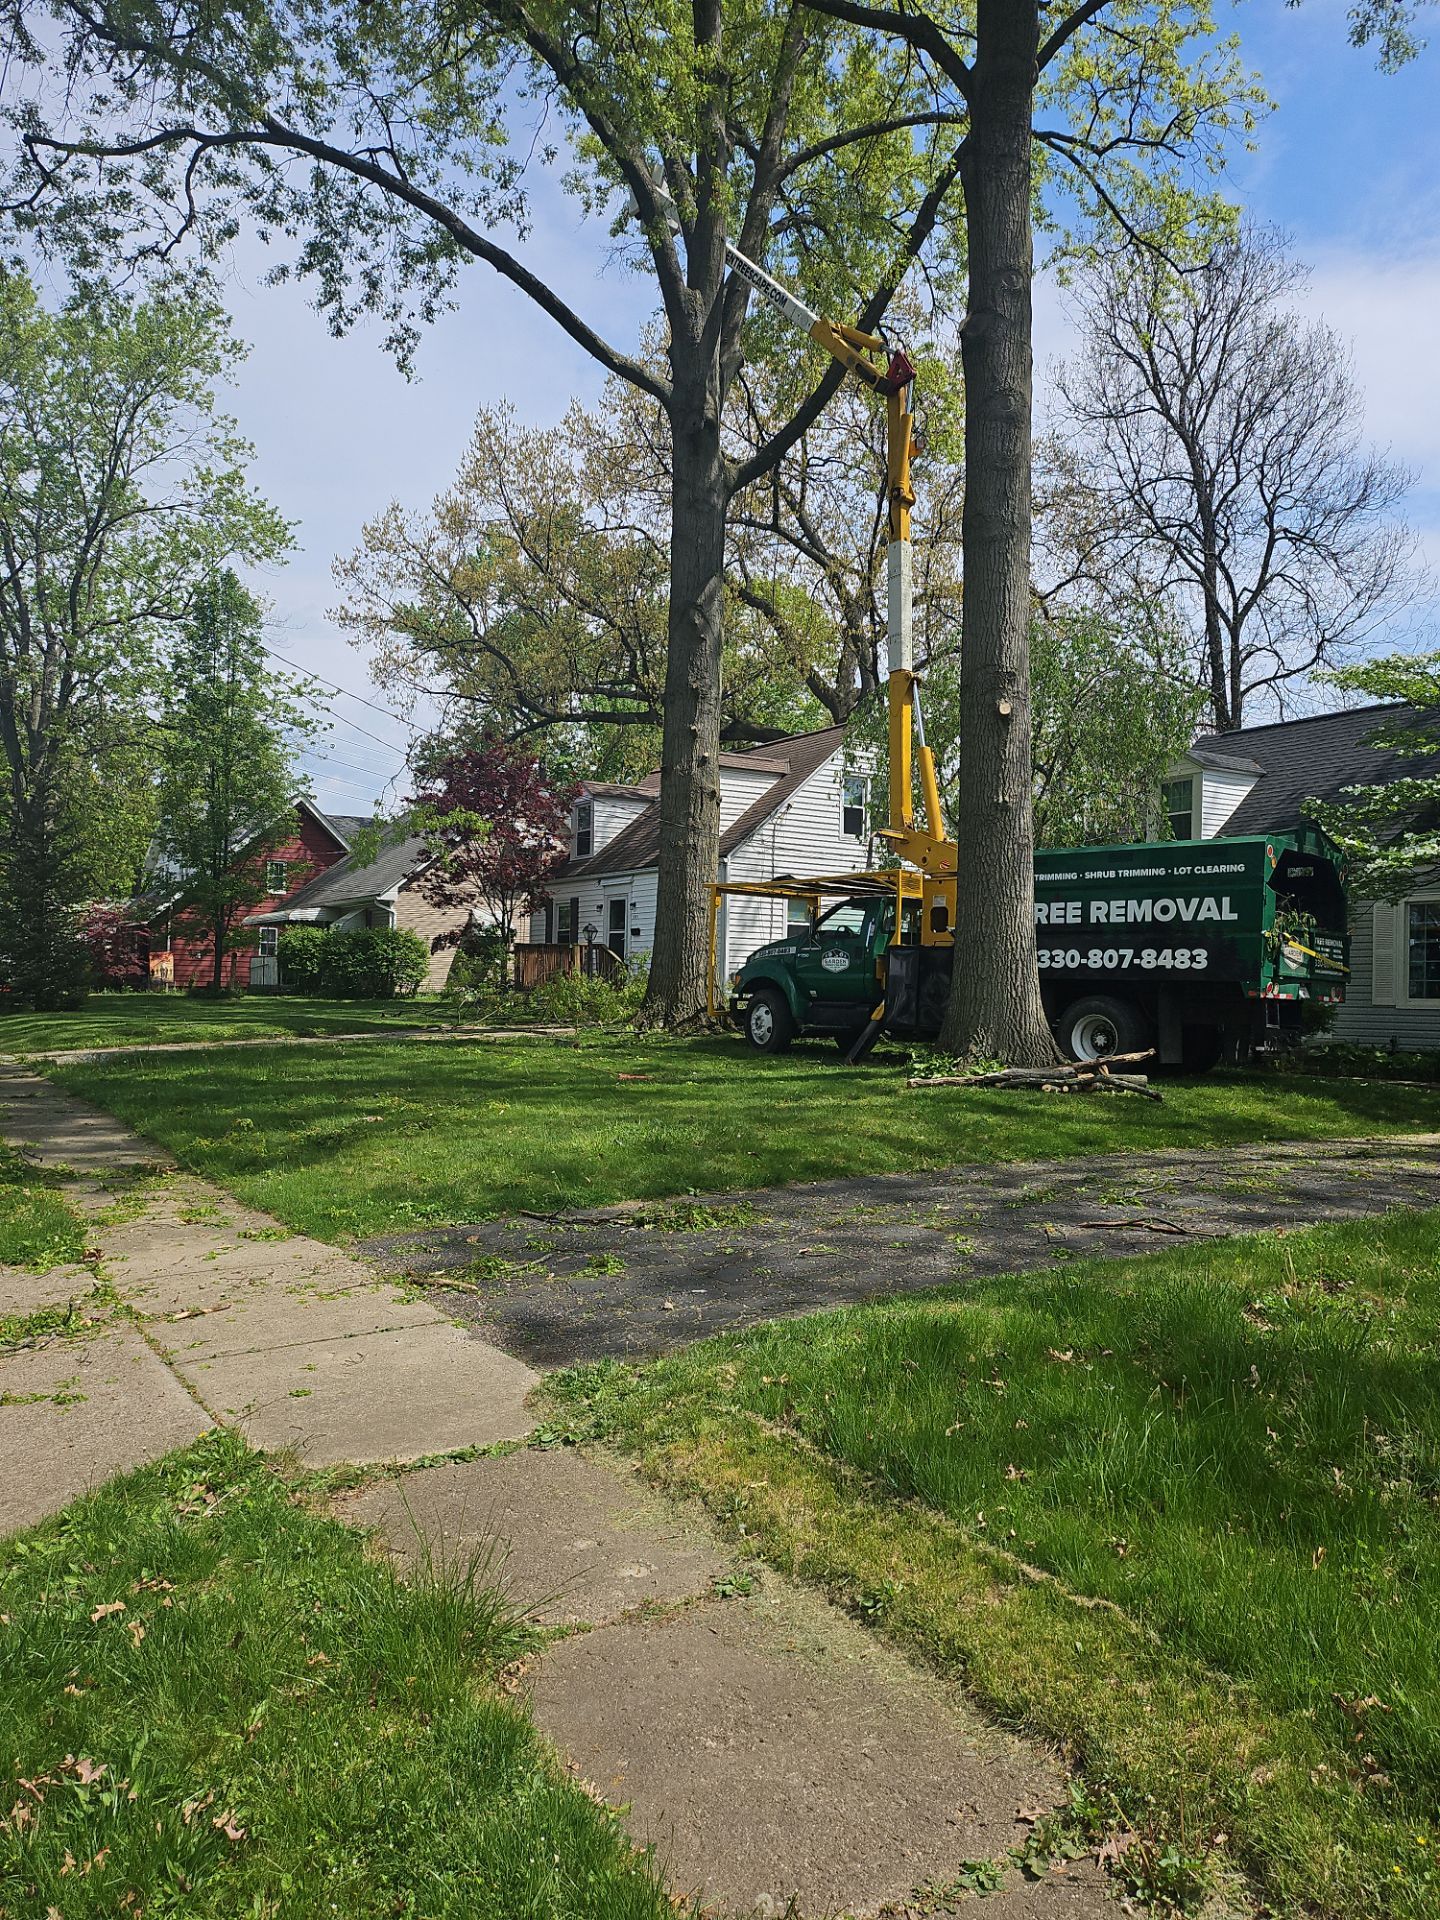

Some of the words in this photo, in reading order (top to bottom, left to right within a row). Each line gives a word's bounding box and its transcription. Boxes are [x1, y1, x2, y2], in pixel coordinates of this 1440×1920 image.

[725, 250, 788, 308] ENTREESCAPE.COM
[1034, 872, 1078, 881] TRIMMING
[1084, 870, 1116, 879] SHRUB
[1118, 867, 1166, 877] TRIMMING
[1173, 866, 1192, 875] LOT
[1194, 863, 1245, 874] CLEARING
[1034, 902, 1082, 924] REE
[1089, 897, 1238, 923] REMOVAL
[1037, 948, 1209, 969] 330-807-8483
